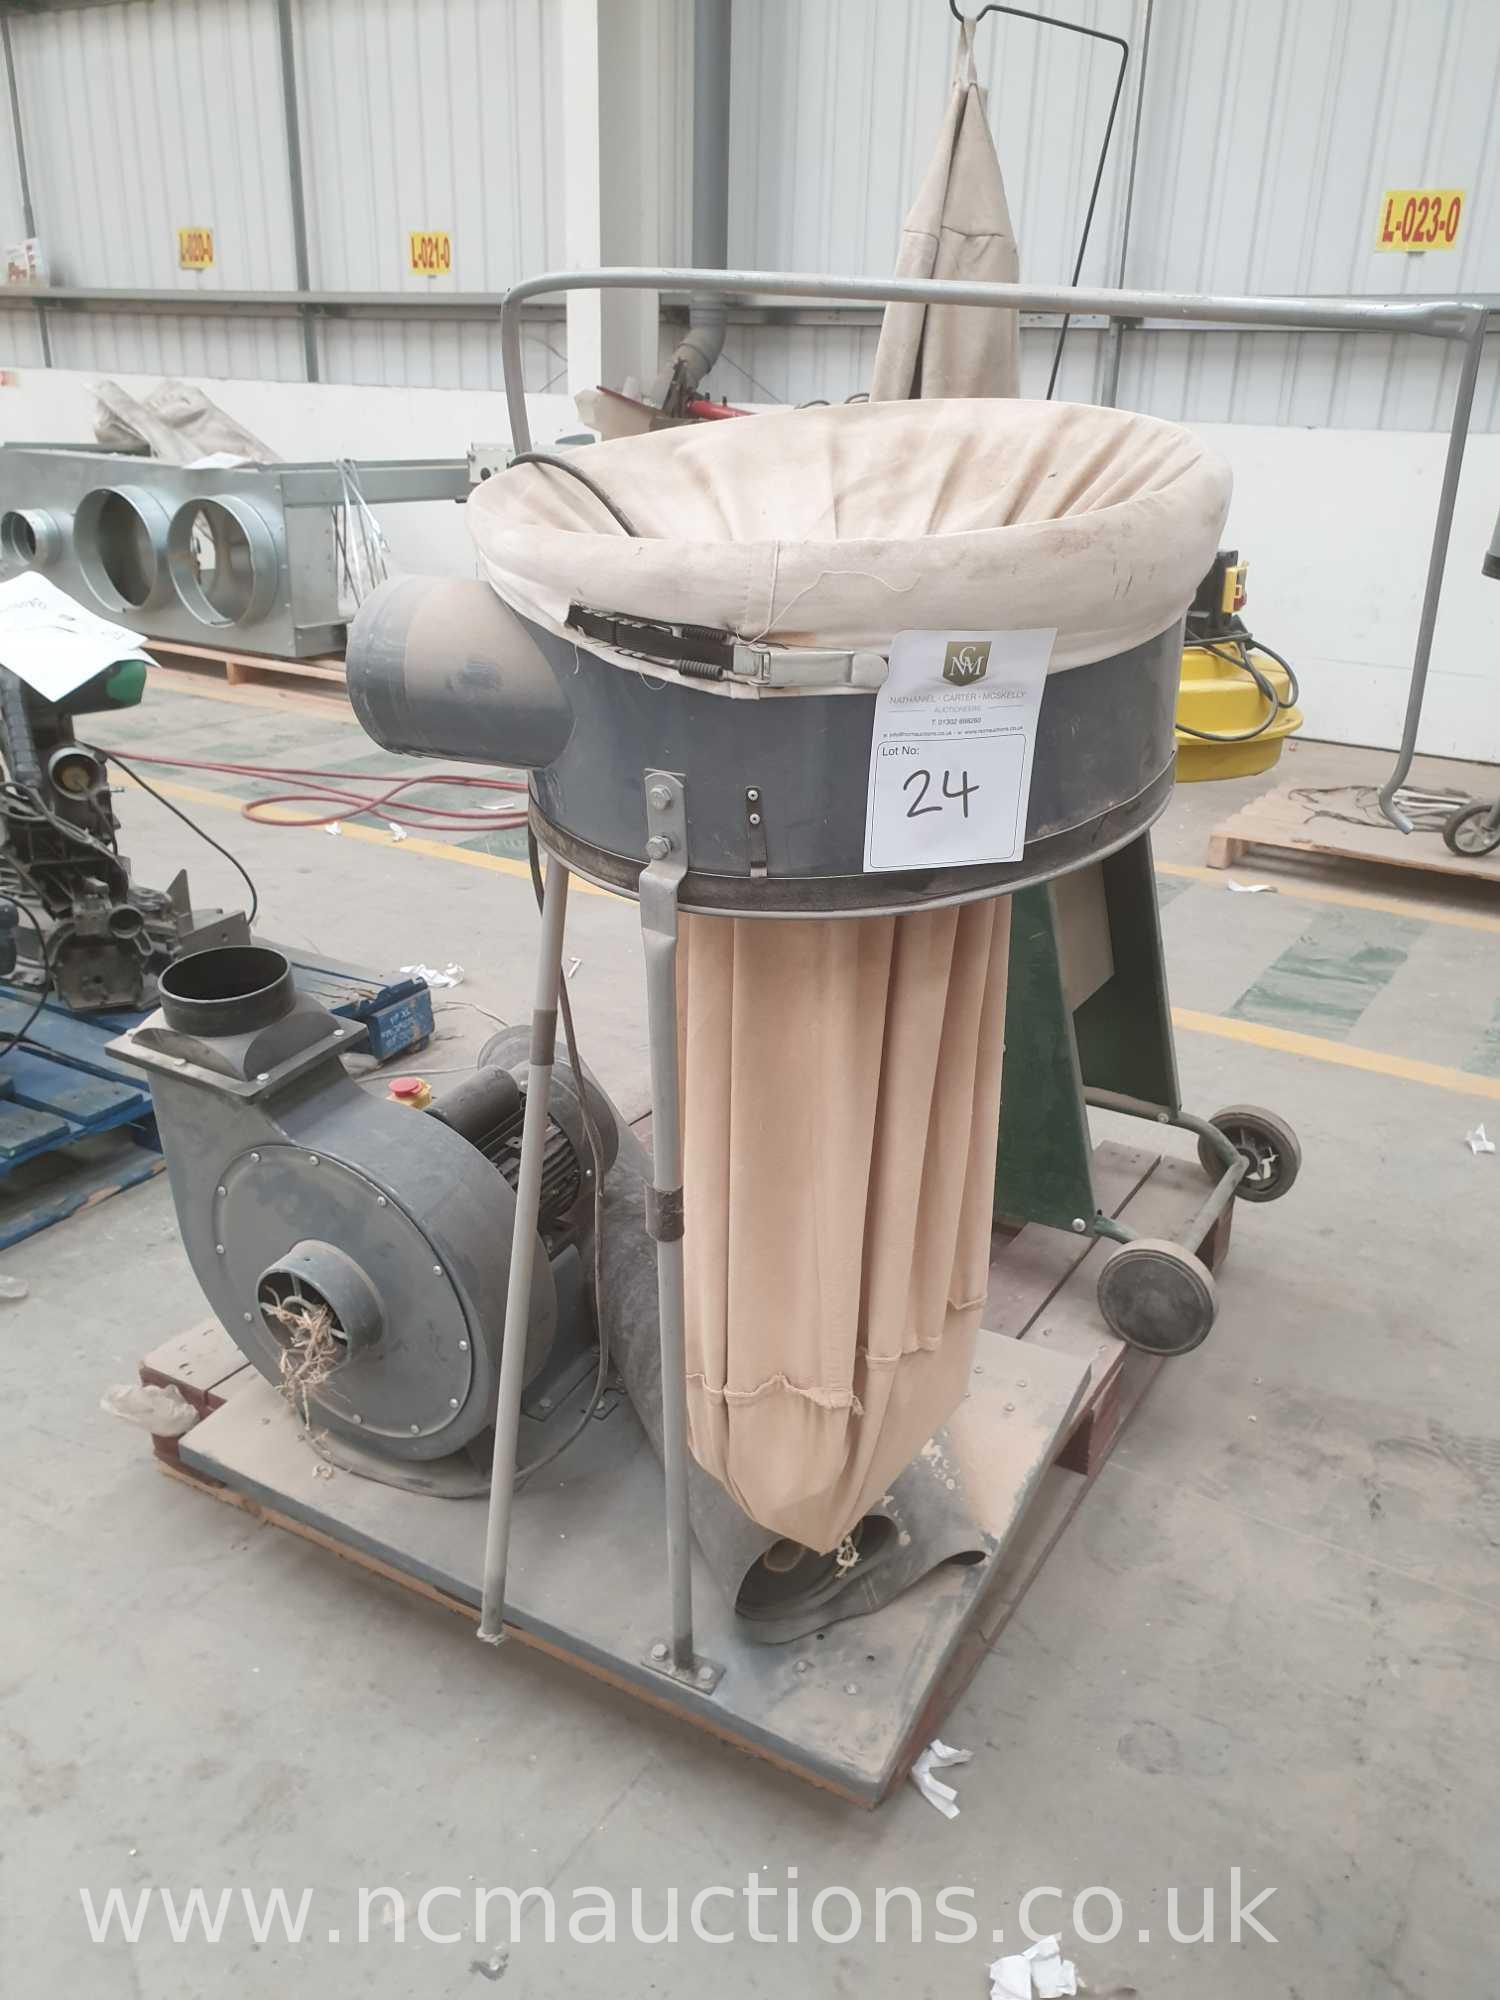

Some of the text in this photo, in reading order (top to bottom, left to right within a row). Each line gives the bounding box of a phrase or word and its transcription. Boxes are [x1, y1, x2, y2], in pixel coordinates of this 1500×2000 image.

[1381, 196, 1461, 242] L-023-0
[411, 236, 450, 268] L-021-0
[943, 692, 976, 702] CARTER
[882, 745, 920, 757] Lot No:
[903, 769, 980, 818] 24
